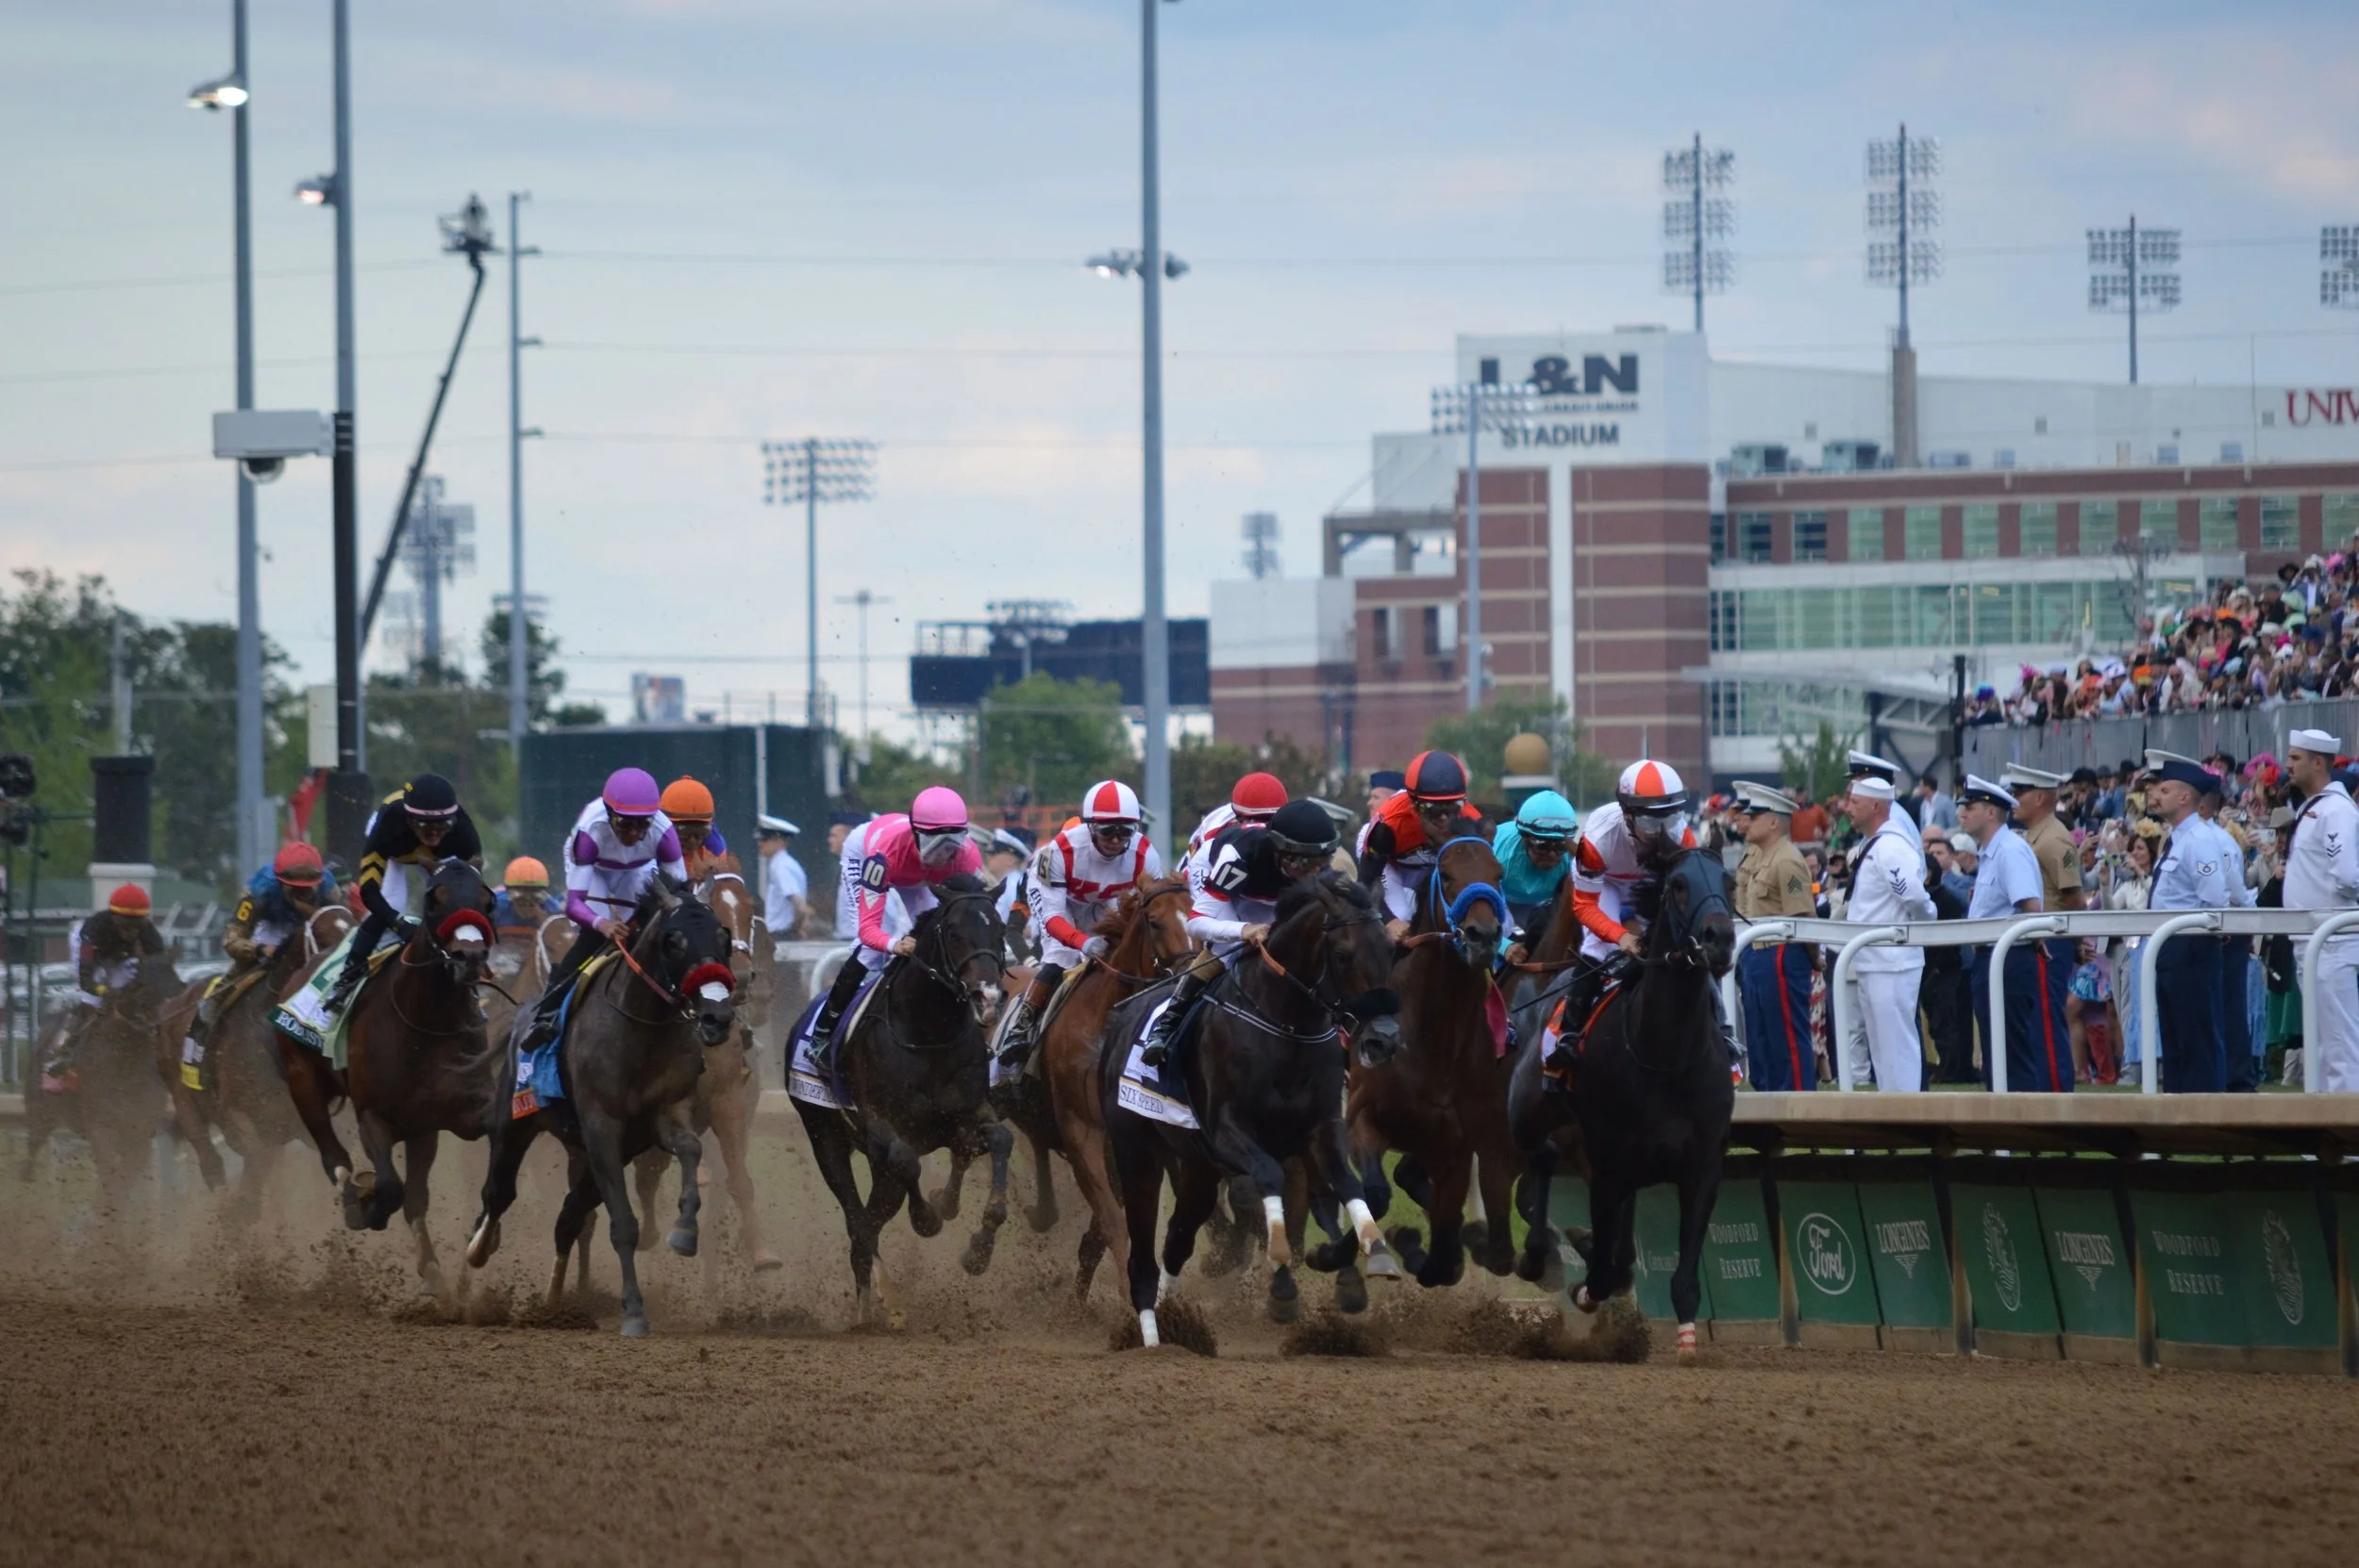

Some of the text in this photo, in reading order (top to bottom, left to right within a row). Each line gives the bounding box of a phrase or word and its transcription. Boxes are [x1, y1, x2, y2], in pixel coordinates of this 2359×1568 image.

[1501, 423, 1620, 448] STADIUM
[862, 859, 885, 887] 10
[1038, 853, 1049, 879] 15
[1215, 863, 1248, 891] 17
[1708, 1223, 1759, 1243] WOODFORD
[1874, 1220, 1932, 1254] LONGINES
[2151, 1230, 2221, 1257] WOODFORD
[1809, 1223, 1846, 1281] Ford
[2054, 1231, 2116, 1266] LONGINES
[1719, 1258, 1762, 1279] RESERVE
[2167, 1269, 2225, 1295] RESERVE
